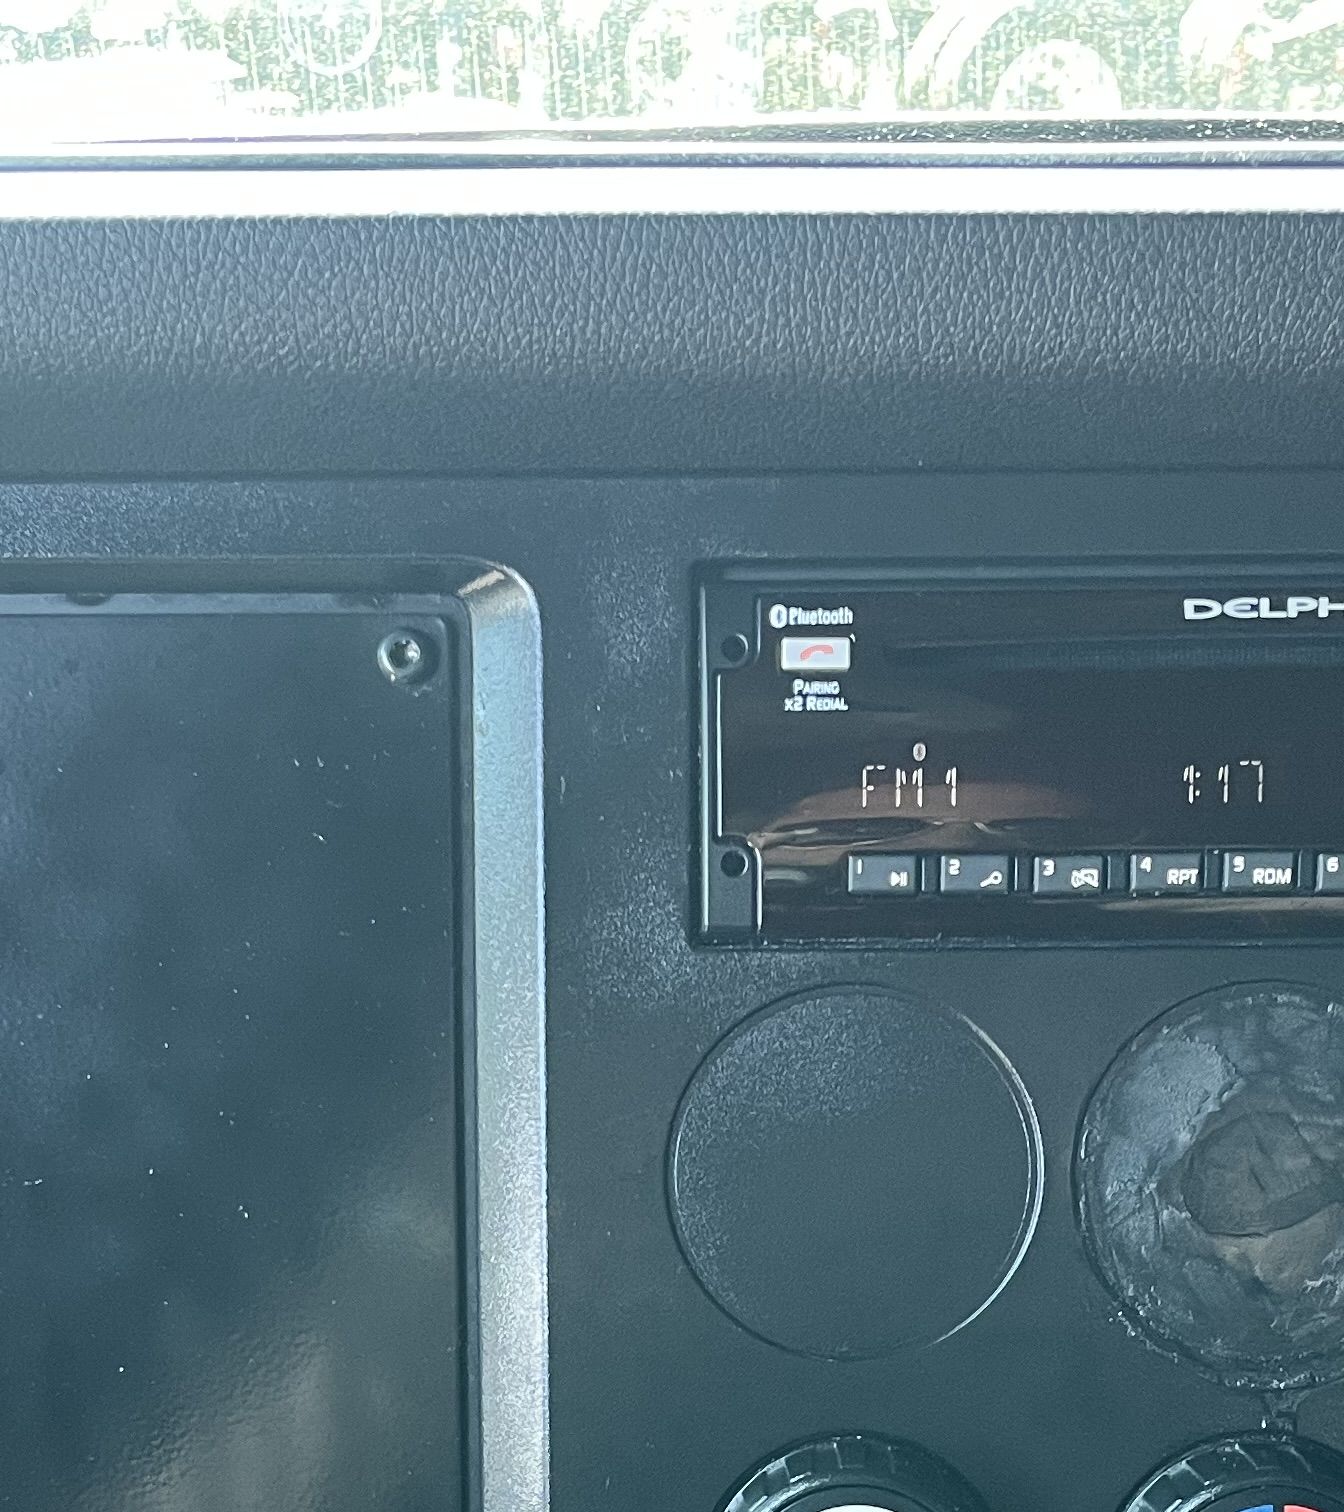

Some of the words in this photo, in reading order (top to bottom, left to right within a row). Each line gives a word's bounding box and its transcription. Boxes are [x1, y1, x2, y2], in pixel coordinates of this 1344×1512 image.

[806, 696, 848, 711] REDIAL
[1183, 761, 1263, 804] 1:17
[857, 858, 862, 875] 1
[948, 858, 960, 876] 2
[1043, 859, 1054, 877] 3
[1140, 856, 1152, 873] 4
[1326, 857, 1339, 873] 6
[1167, 868, 1199, 885] RPT
[1252, 868, 1292, 885] RDM
